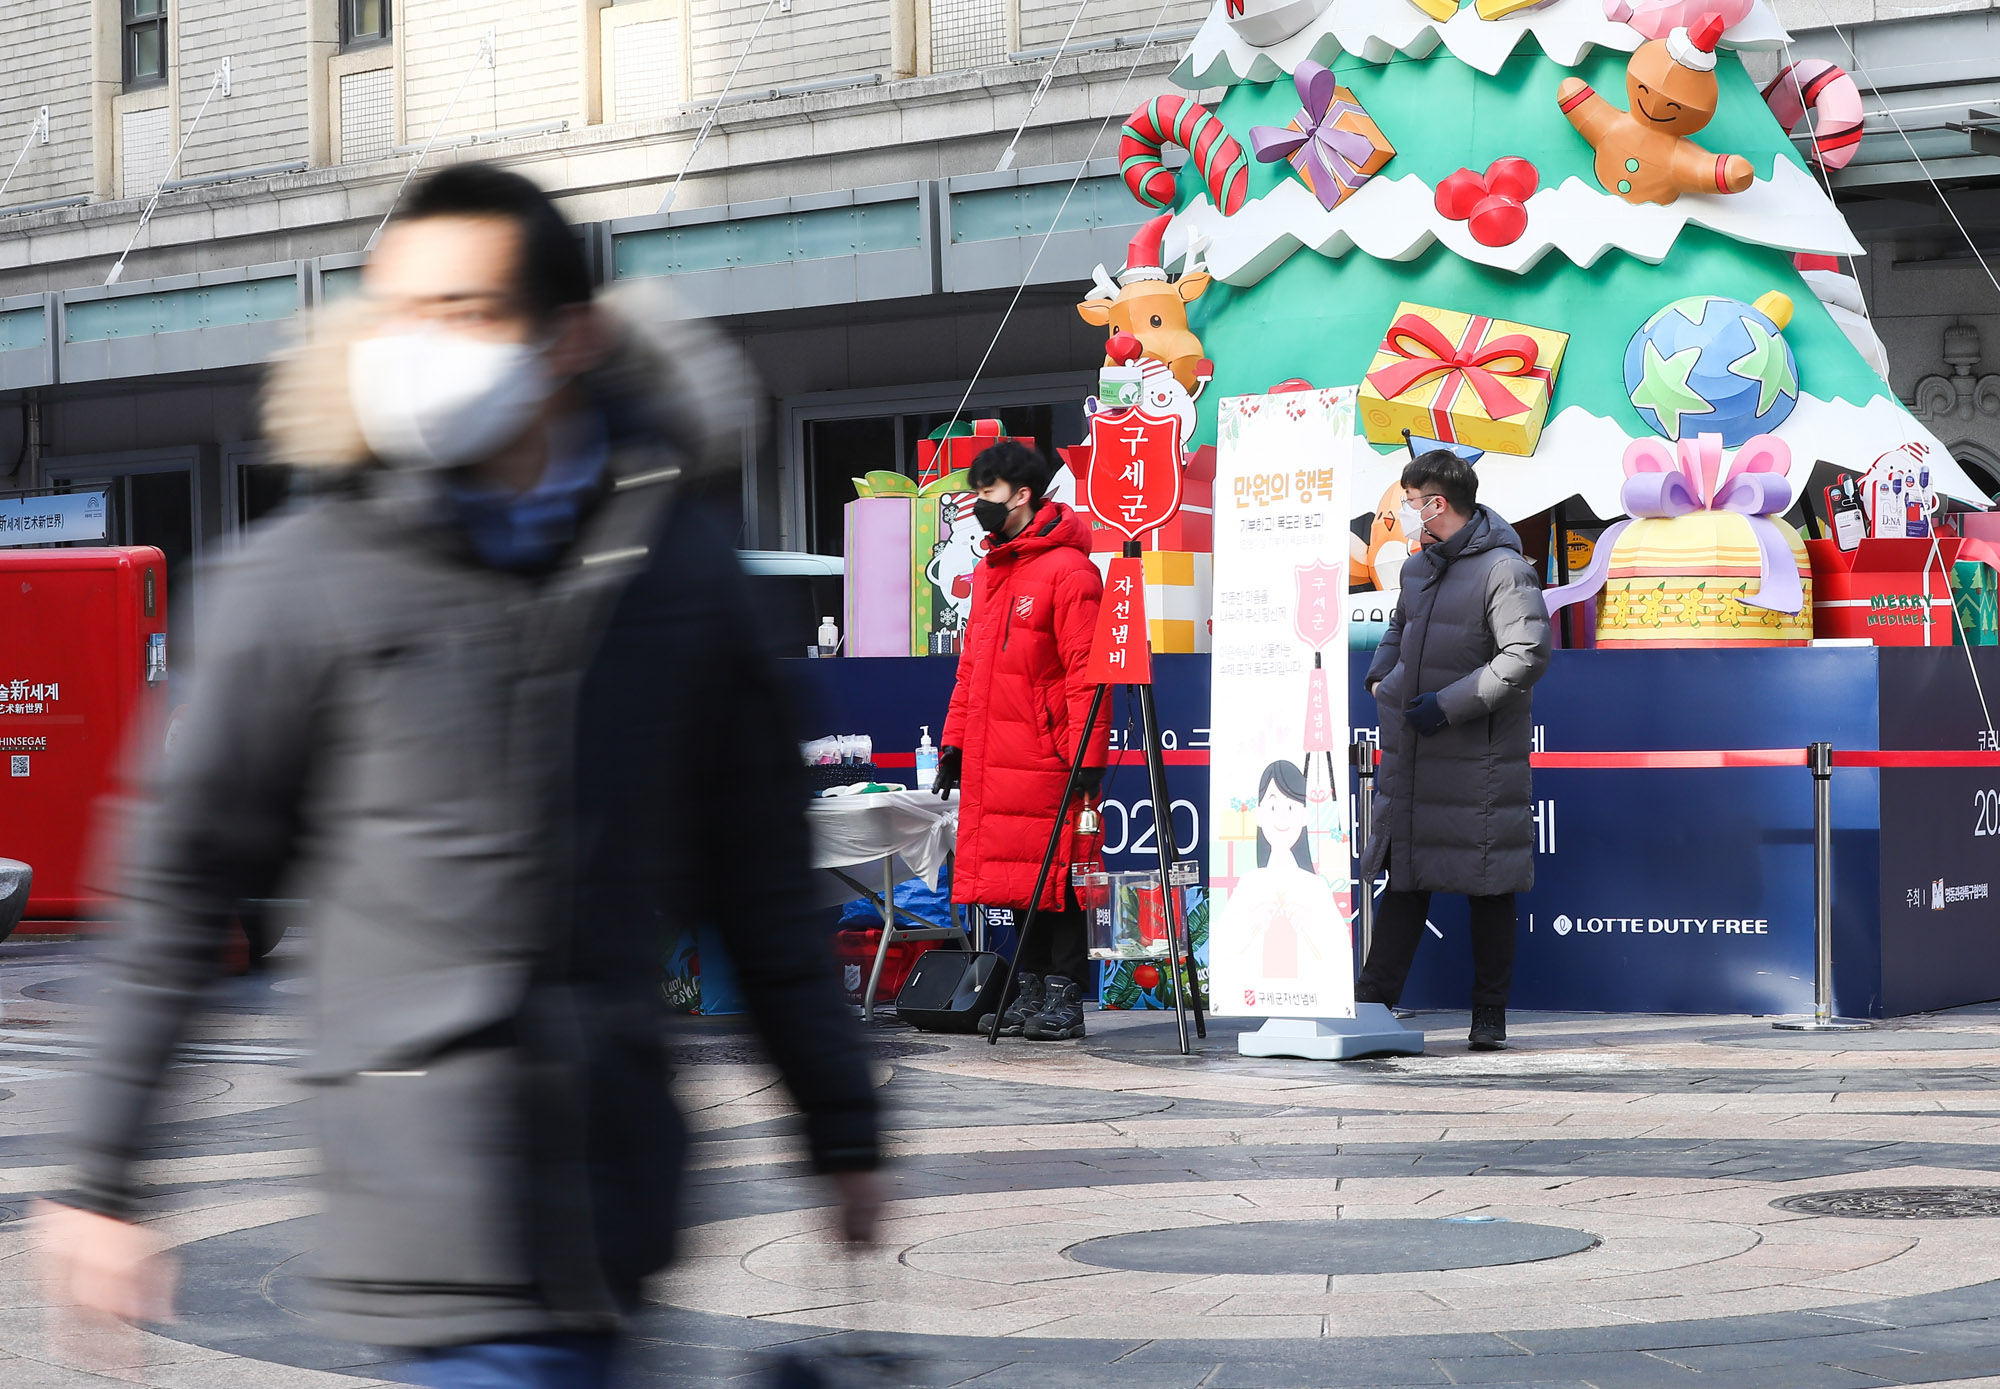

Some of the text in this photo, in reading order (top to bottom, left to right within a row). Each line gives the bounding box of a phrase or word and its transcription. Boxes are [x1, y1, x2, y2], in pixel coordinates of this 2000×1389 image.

[1118, 426, 1149, 523] 구세군
[1234, 467, 1333, 509] 만원의 행복
[1109, 575, 1134, 669] 자선냄비
[1312, 577, 1326, 631] 구세군
[1867, 613, 1936, 626] MEDIHEAL
[1870, 593, 1934, 611] MERRY
[1312, 679, 1323, 744] 자선냄비
[1906, 887, 1920, 908] 주최
[1576, 918, 1768, 934] LOTTE DUTY FREE
